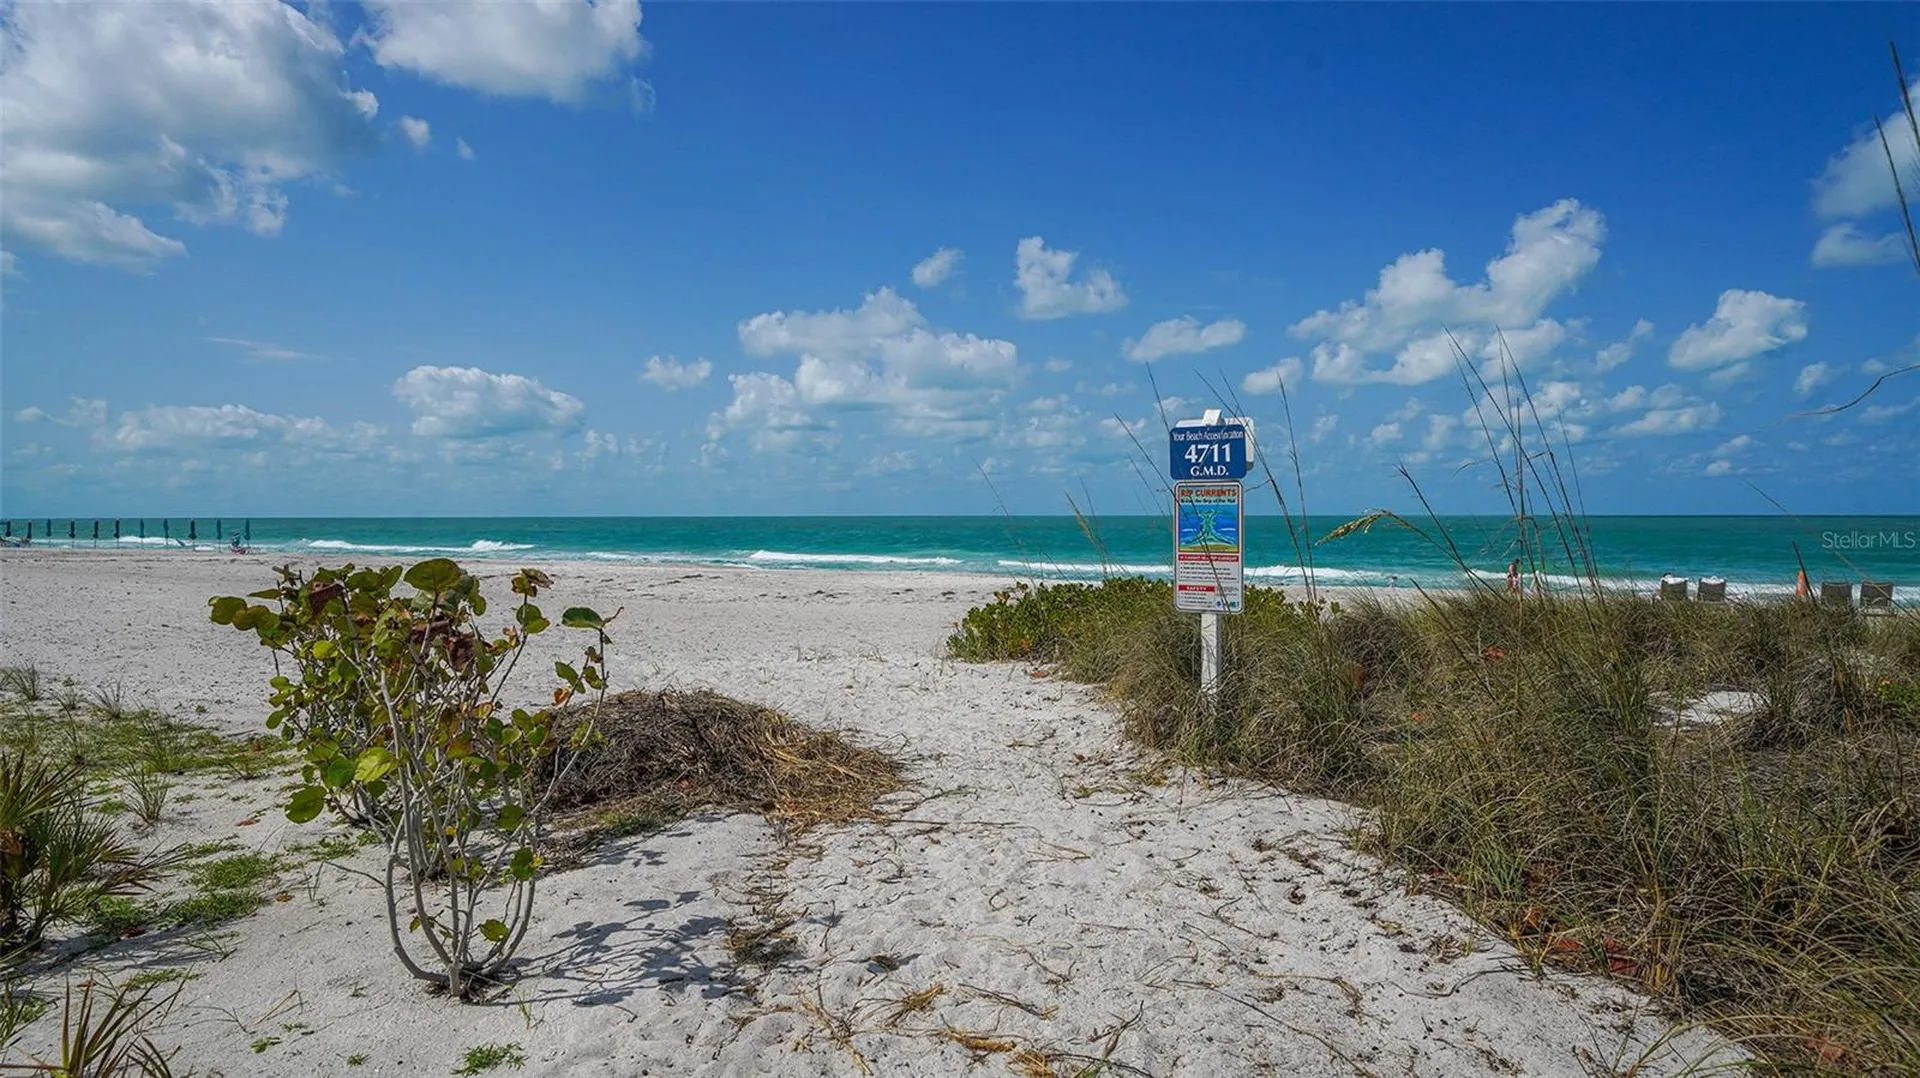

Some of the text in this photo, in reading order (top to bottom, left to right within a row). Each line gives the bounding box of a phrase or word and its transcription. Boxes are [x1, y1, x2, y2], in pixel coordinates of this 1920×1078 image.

[1172, 431, 1185, 441] Your
[1186, 430, 1203, 441] Beach
[1184, 443, 1231, 463] 4711
[1190, 465, 1229, 477] G.M.D.
[1195, 488, 1237, 497] CURRENTS
